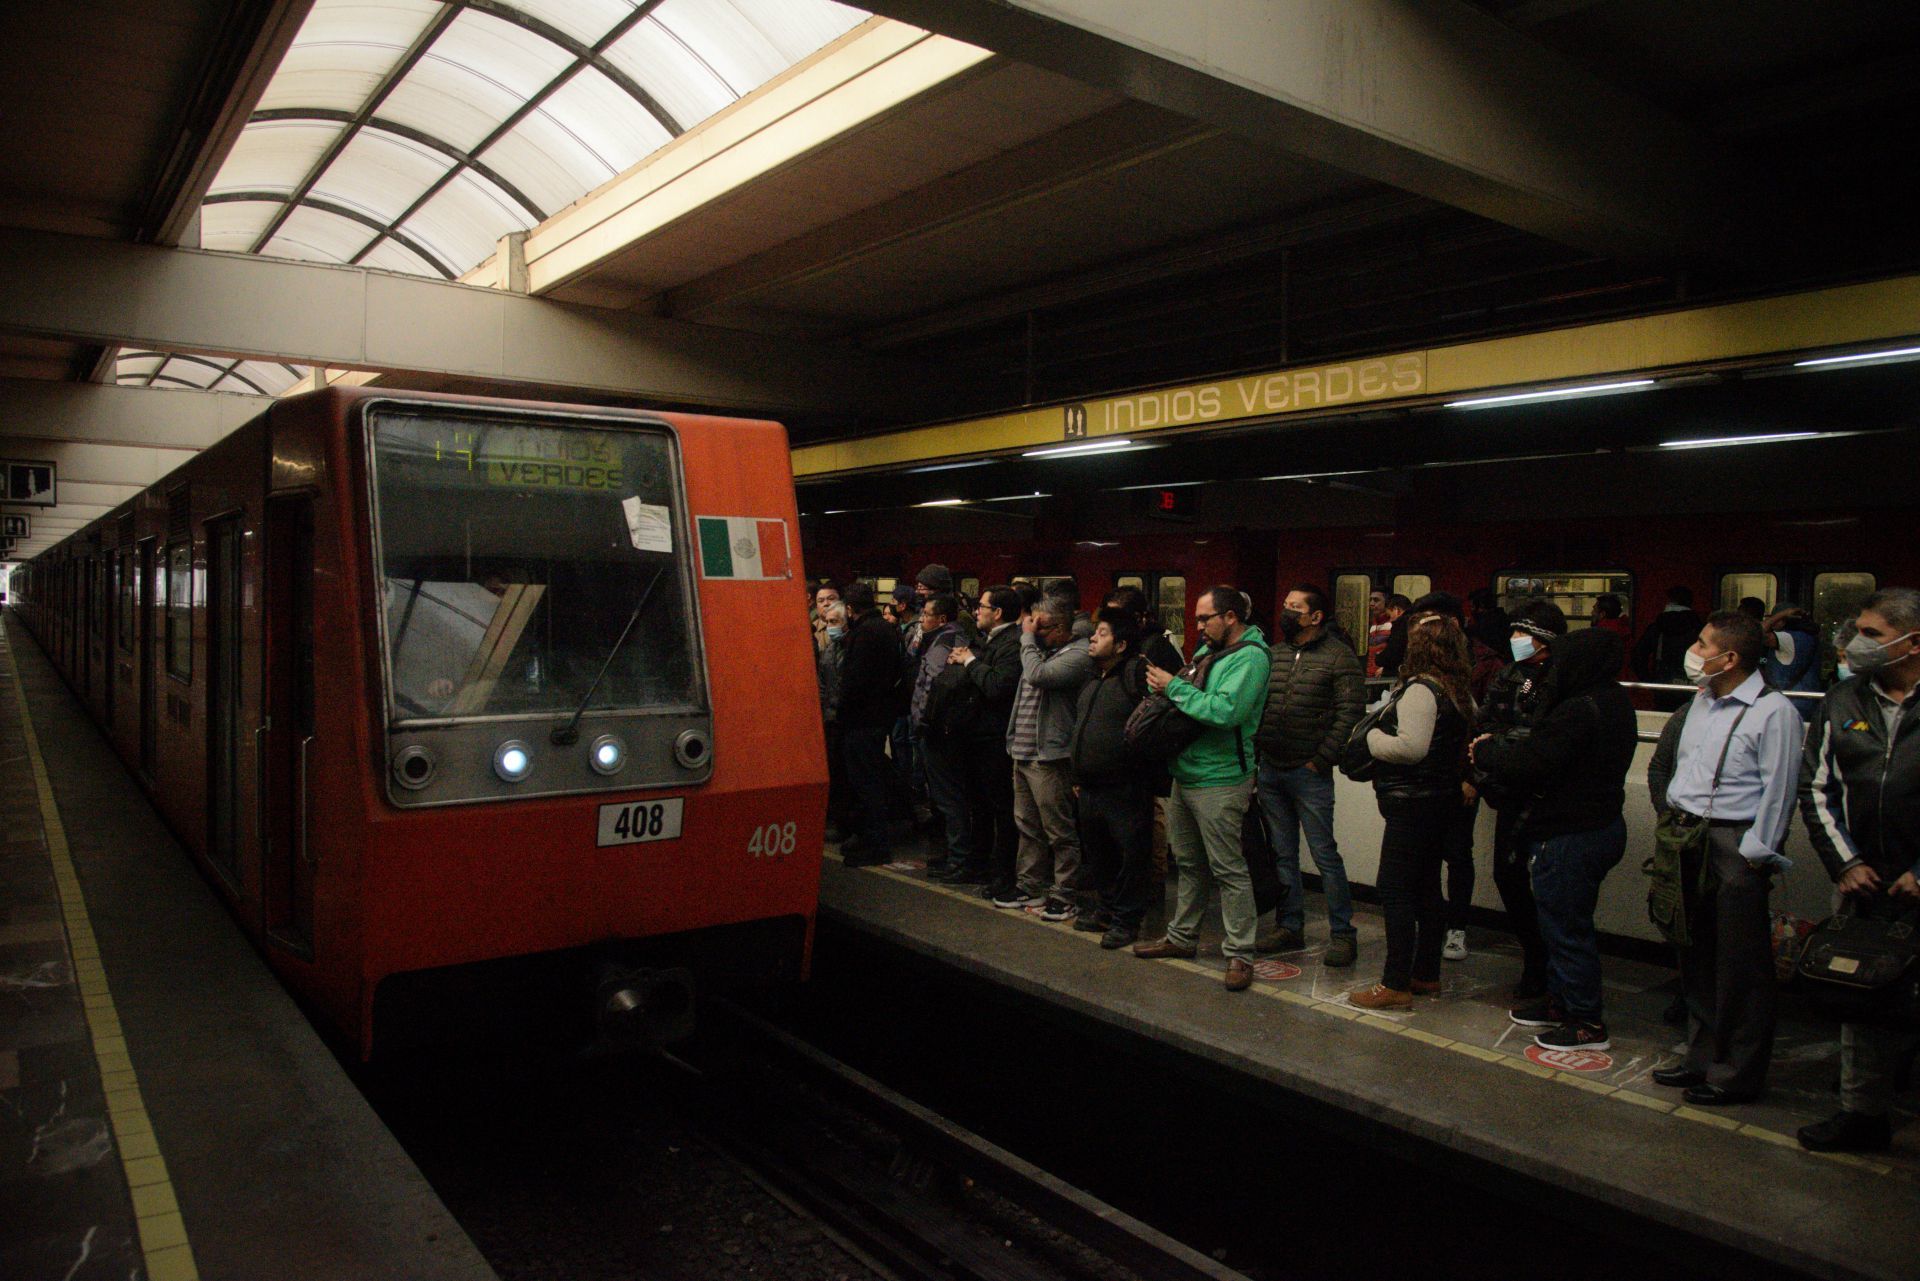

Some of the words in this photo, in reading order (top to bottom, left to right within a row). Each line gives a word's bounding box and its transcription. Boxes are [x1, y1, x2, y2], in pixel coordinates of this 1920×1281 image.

[1105, 386, 1221, 431] INDIOS
[1237, 356, 1421, 412] VERDES
[500, 461, 624, 489] VERDES
[615, 804, 664, 839] 408
[748, 821, 797, 858] 408
